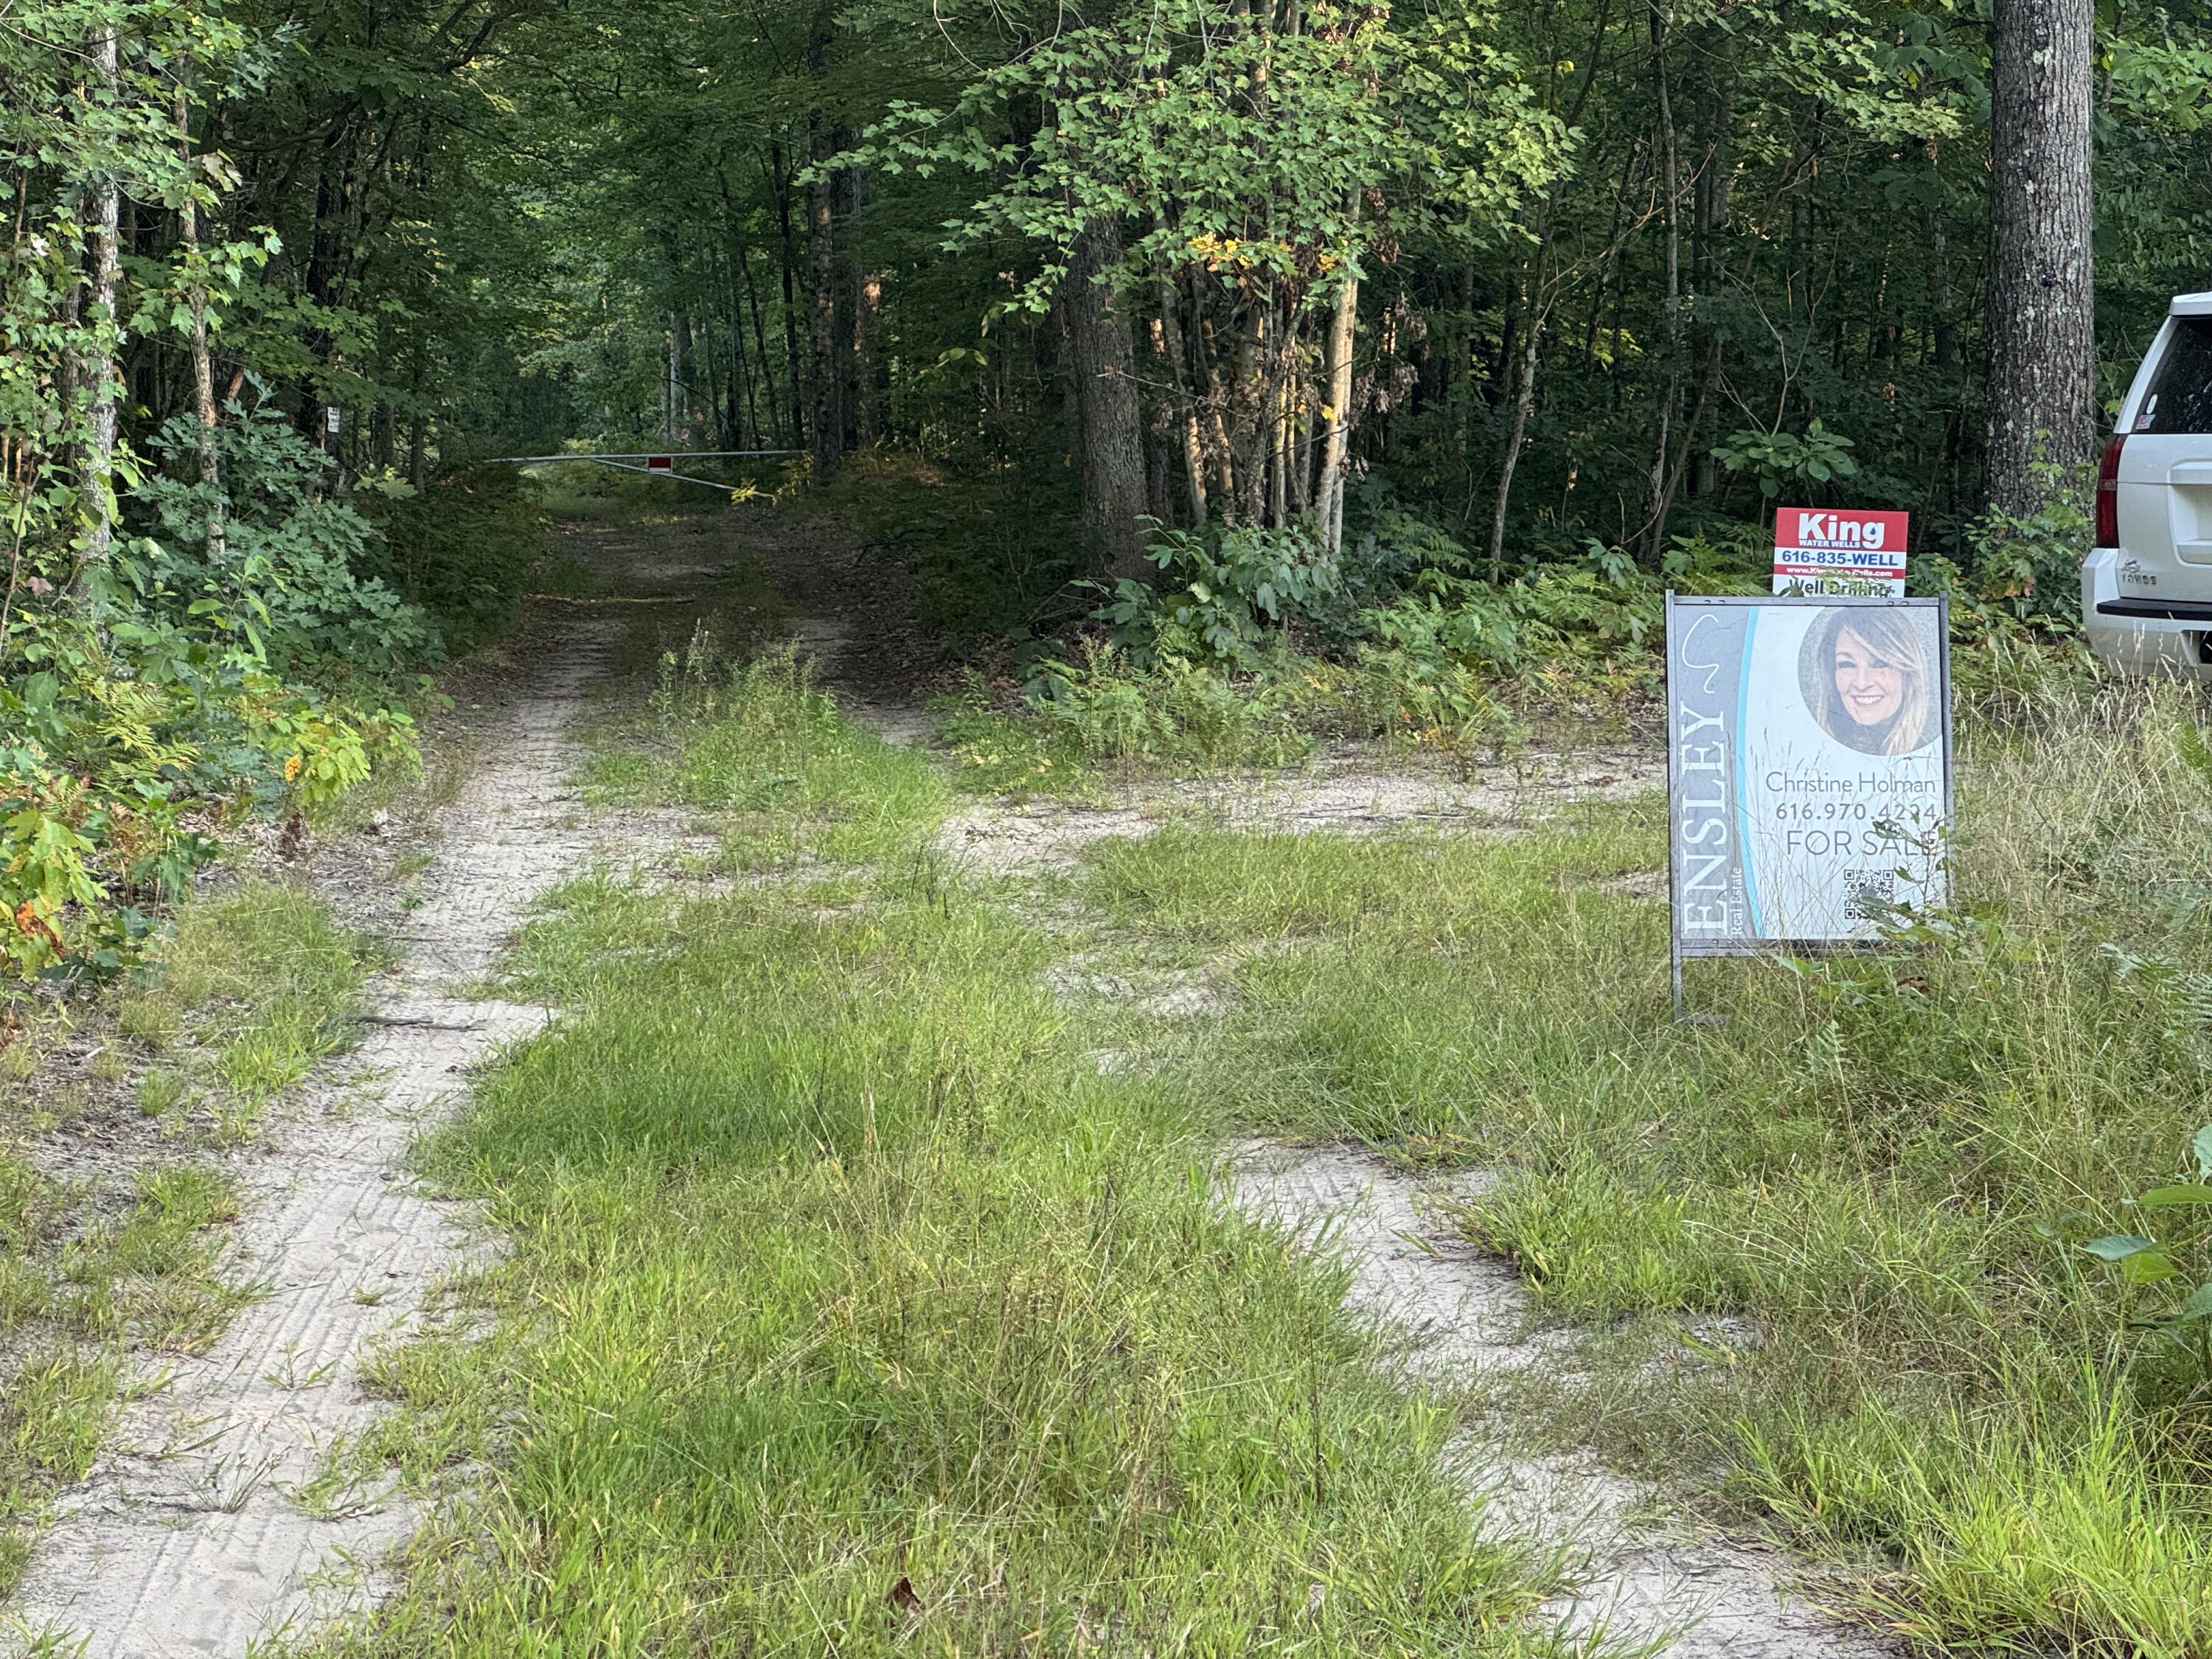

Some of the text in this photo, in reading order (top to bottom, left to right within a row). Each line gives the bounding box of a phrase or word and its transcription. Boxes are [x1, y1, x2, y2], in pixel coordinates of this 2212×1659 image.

[1798, 512, 1885, 549] King
[1782, 550, 1899, 566] 616-835-WELL
[1766, 771, 1936, 793] Christine Holman
[1680, 700, 1728, 935] ENSLEY
[1787, 830, 1852, 855] FOR
[1730, 867, 1742, 936] Real Estate
